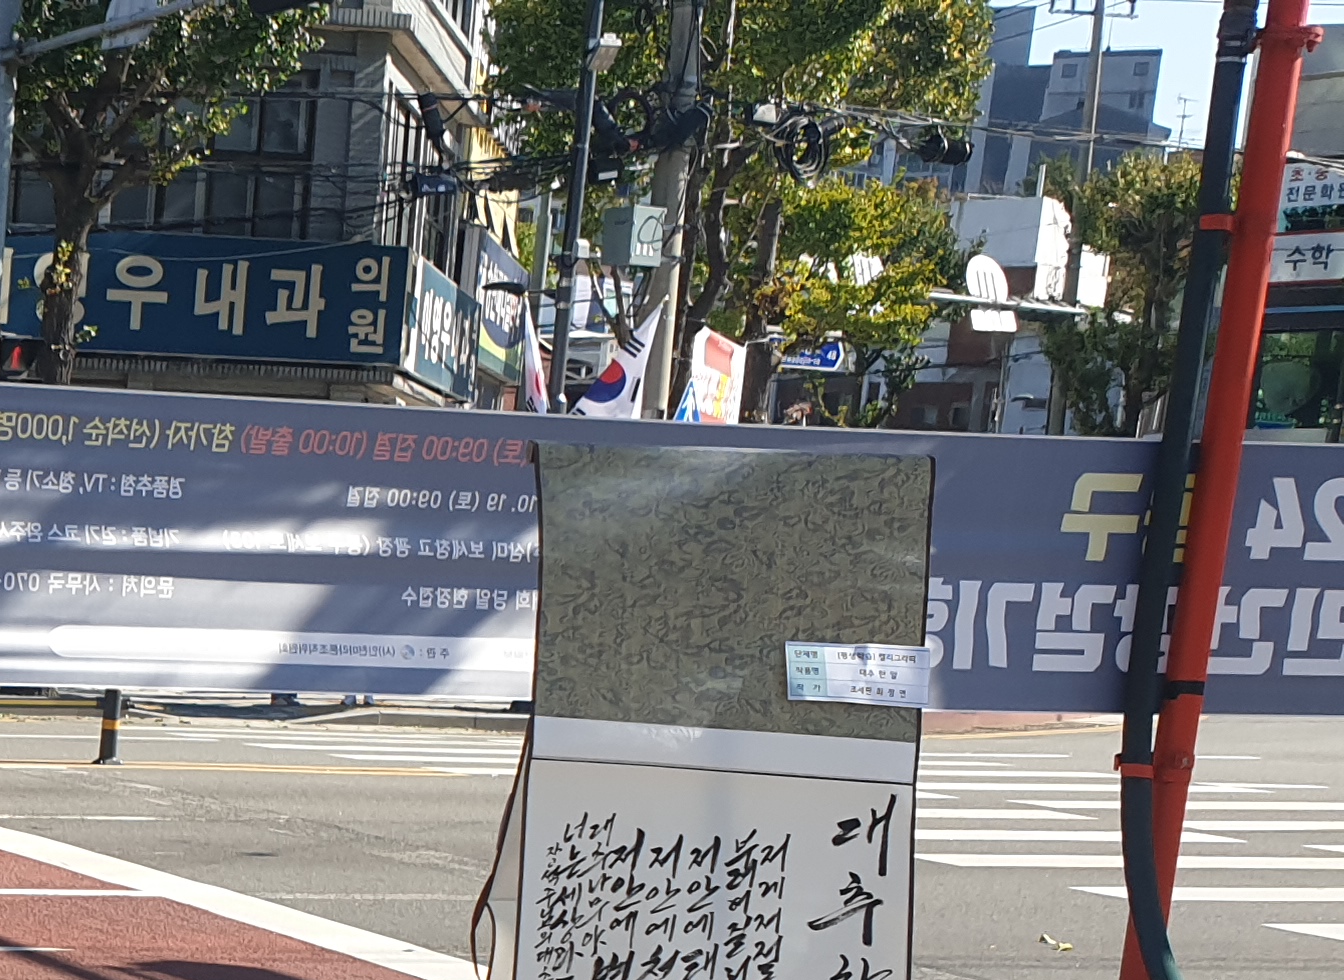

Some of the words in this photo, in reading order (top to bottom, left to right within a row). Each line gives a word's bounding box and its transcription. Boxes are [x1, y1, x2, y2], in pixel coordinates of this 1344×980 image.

[1284, 243, 1334, 271] 수학
[347, 256, 391, 354] 의원
[794, 650, 818, 659] 단체명
